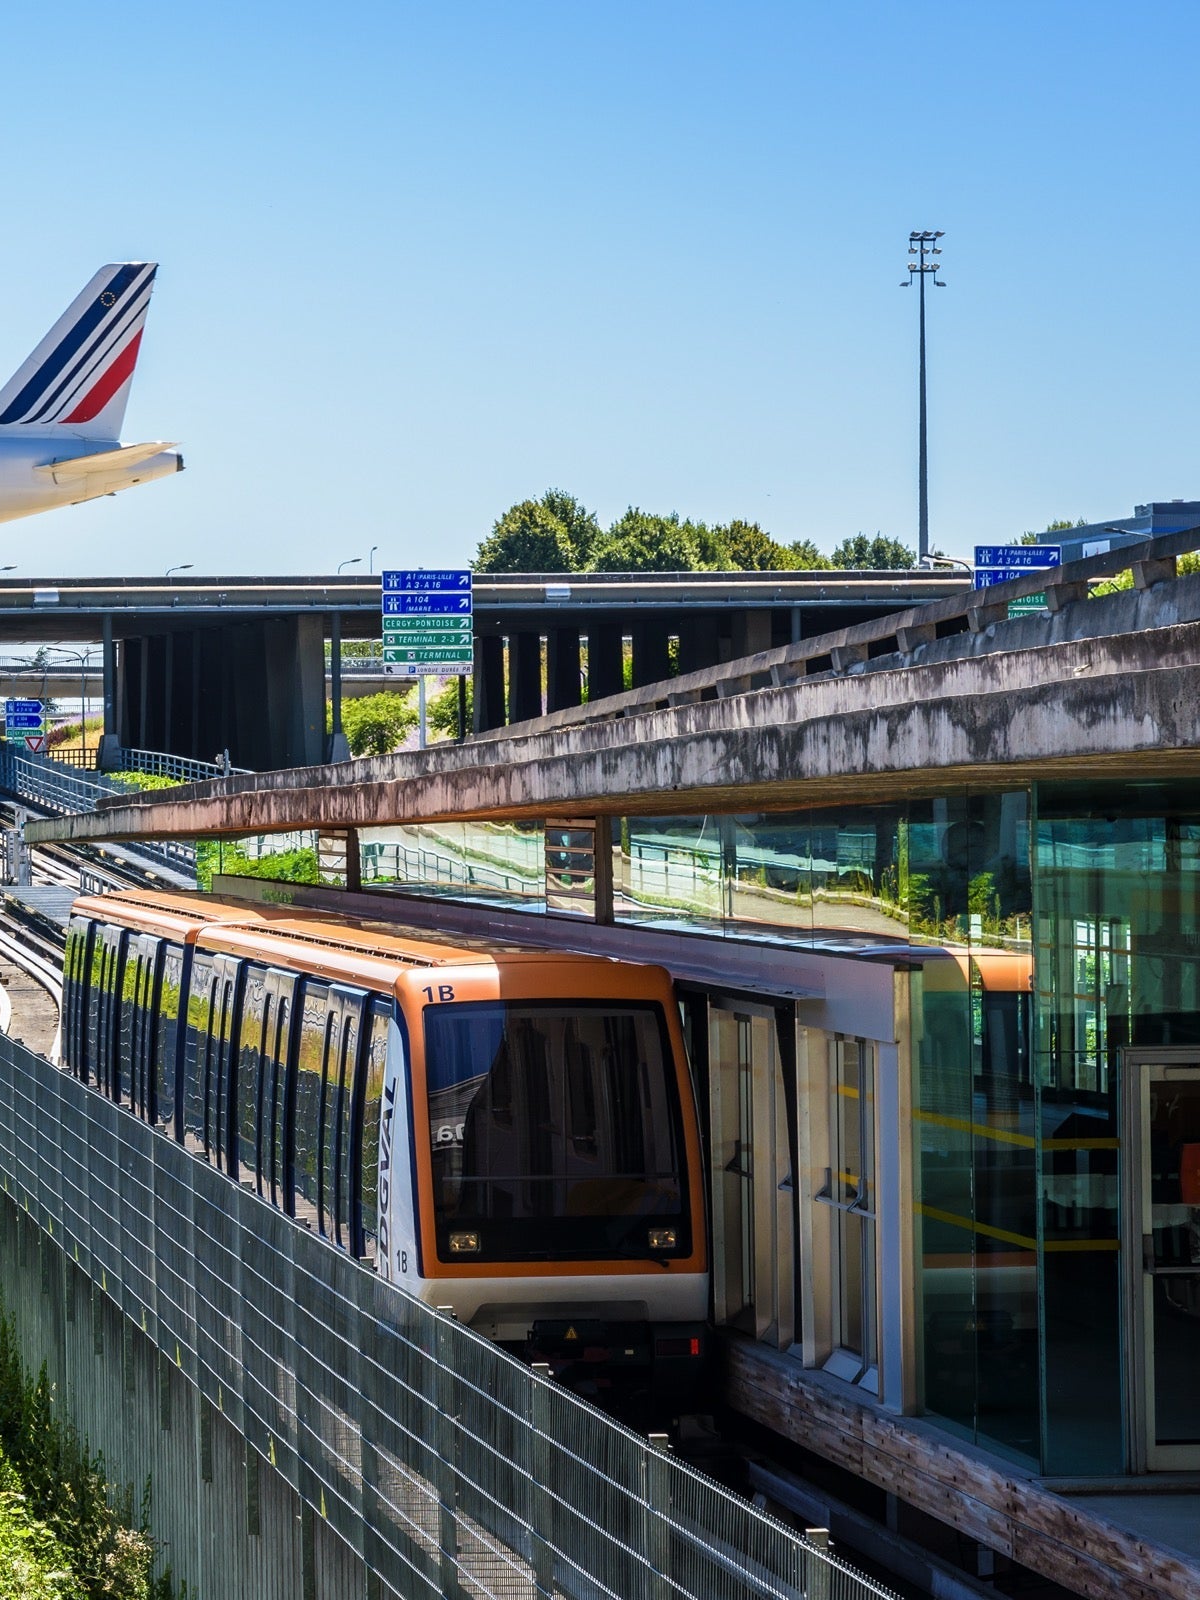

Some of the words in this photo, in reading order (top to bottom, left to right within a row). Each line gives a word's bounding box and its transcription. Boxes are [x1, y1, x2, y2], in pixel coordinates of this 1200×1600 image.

[432, 581, 441, 589] 16
[385, 619, 455, 628] CERGY-PONTOISE
[398, 635, 437, 644] TERMINAL
[441, 635, 455, 643] 2-3
[419, 651, 461, 659] TERMINAL
[466, 651, 471, 659] 1
[422, 985, 455, 1002] 1B
[396, 1249, 408, 1273] 1B
